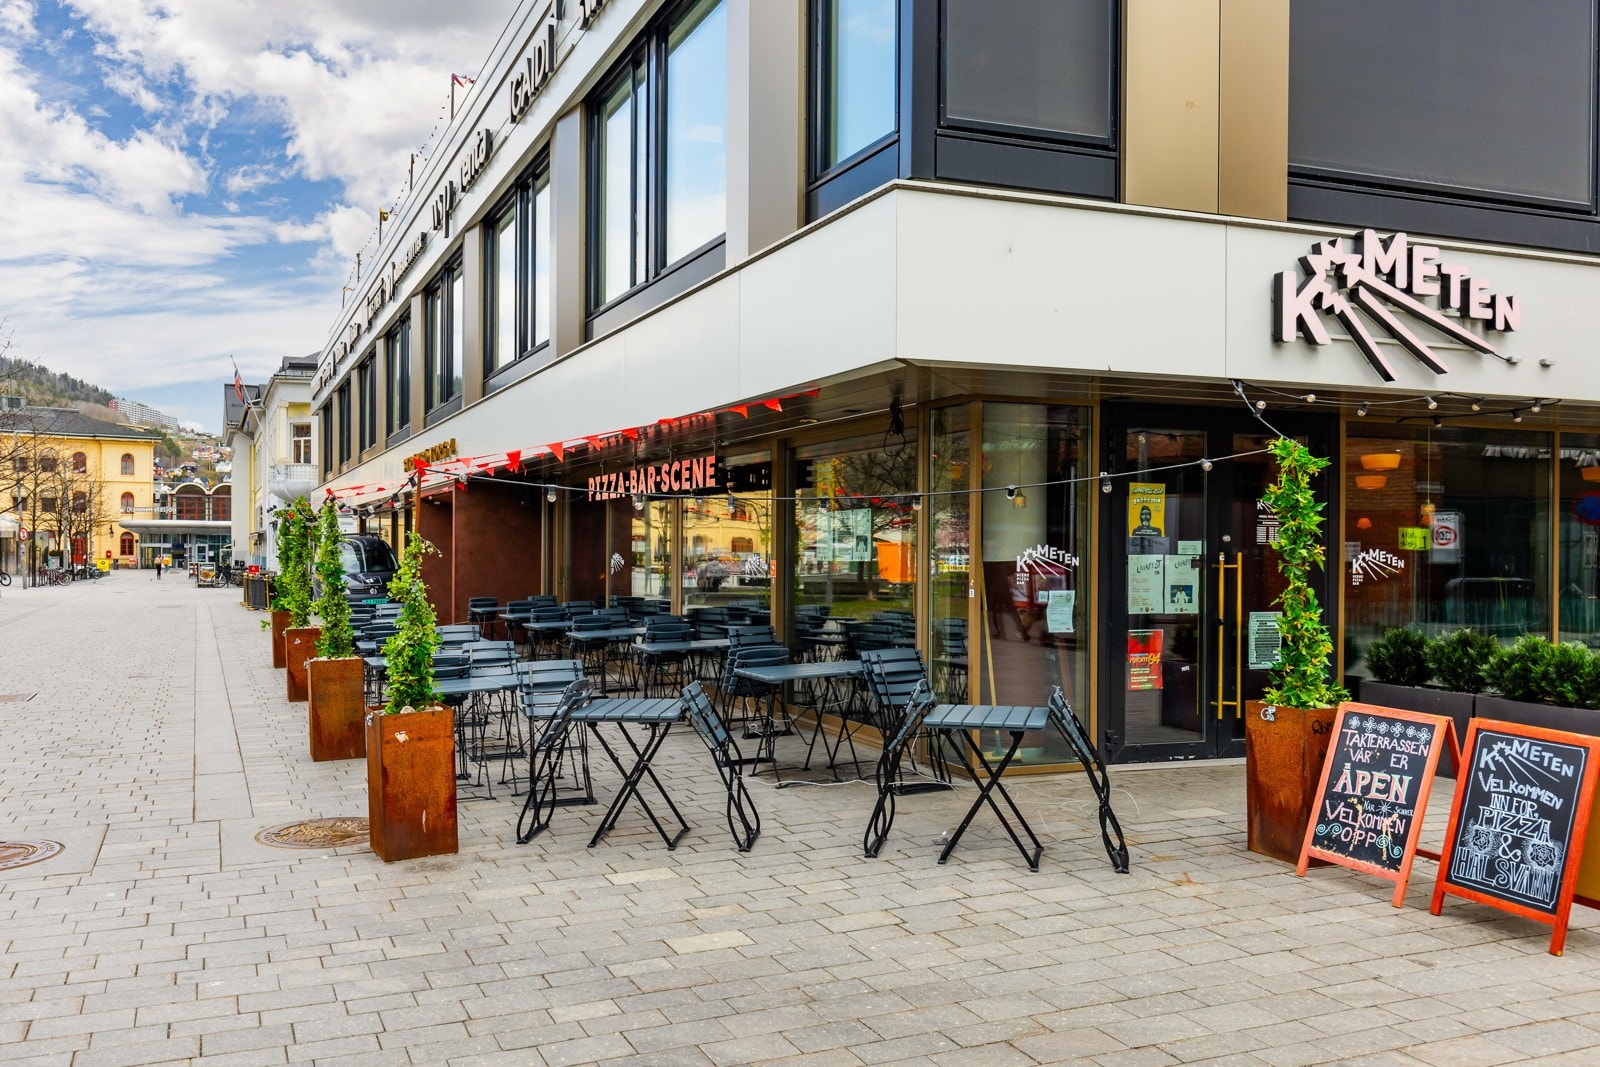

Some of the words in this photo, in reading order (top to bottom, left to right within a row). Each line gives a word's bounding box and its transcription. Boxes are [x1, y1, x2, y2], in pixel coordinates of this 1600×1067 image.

[1342, 728, 1430, 757] TAKTERRASSEN
[1390, 753, 1409, 770] ER
[1332, 763, 1413, 805] ÅPEN
[1478, 771, 1564, 811] VELKOMMEN
[1490, 793, 1509, 812] INN
[1325, 800, 1406, 835] VELKOMMEN
[1477, 806, 1554, 845] PIZZA
[1341, 826, 1377, 848] OPP
[1498, 833, 1522, 862] &
